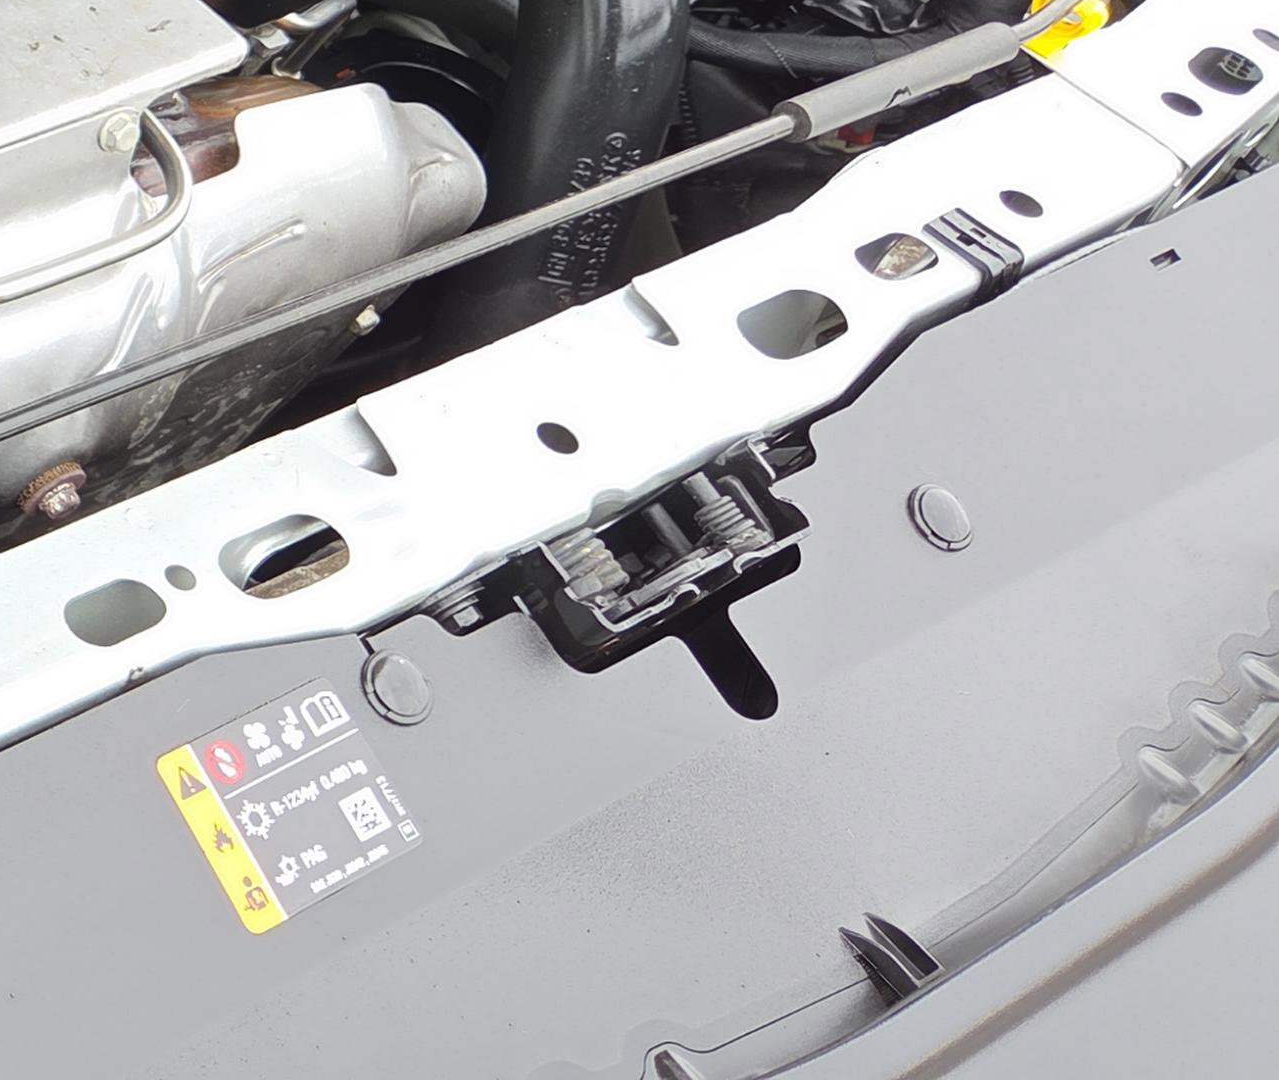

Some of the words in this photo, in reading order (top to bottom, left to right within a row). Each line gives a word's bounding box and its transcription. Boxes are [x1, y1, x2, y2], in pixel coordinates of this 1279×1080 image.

[256, 745, 283, 768] AUTO
[269, 782, 320, 816] R-1234yf
[300, 845, 328, 869] PAG
